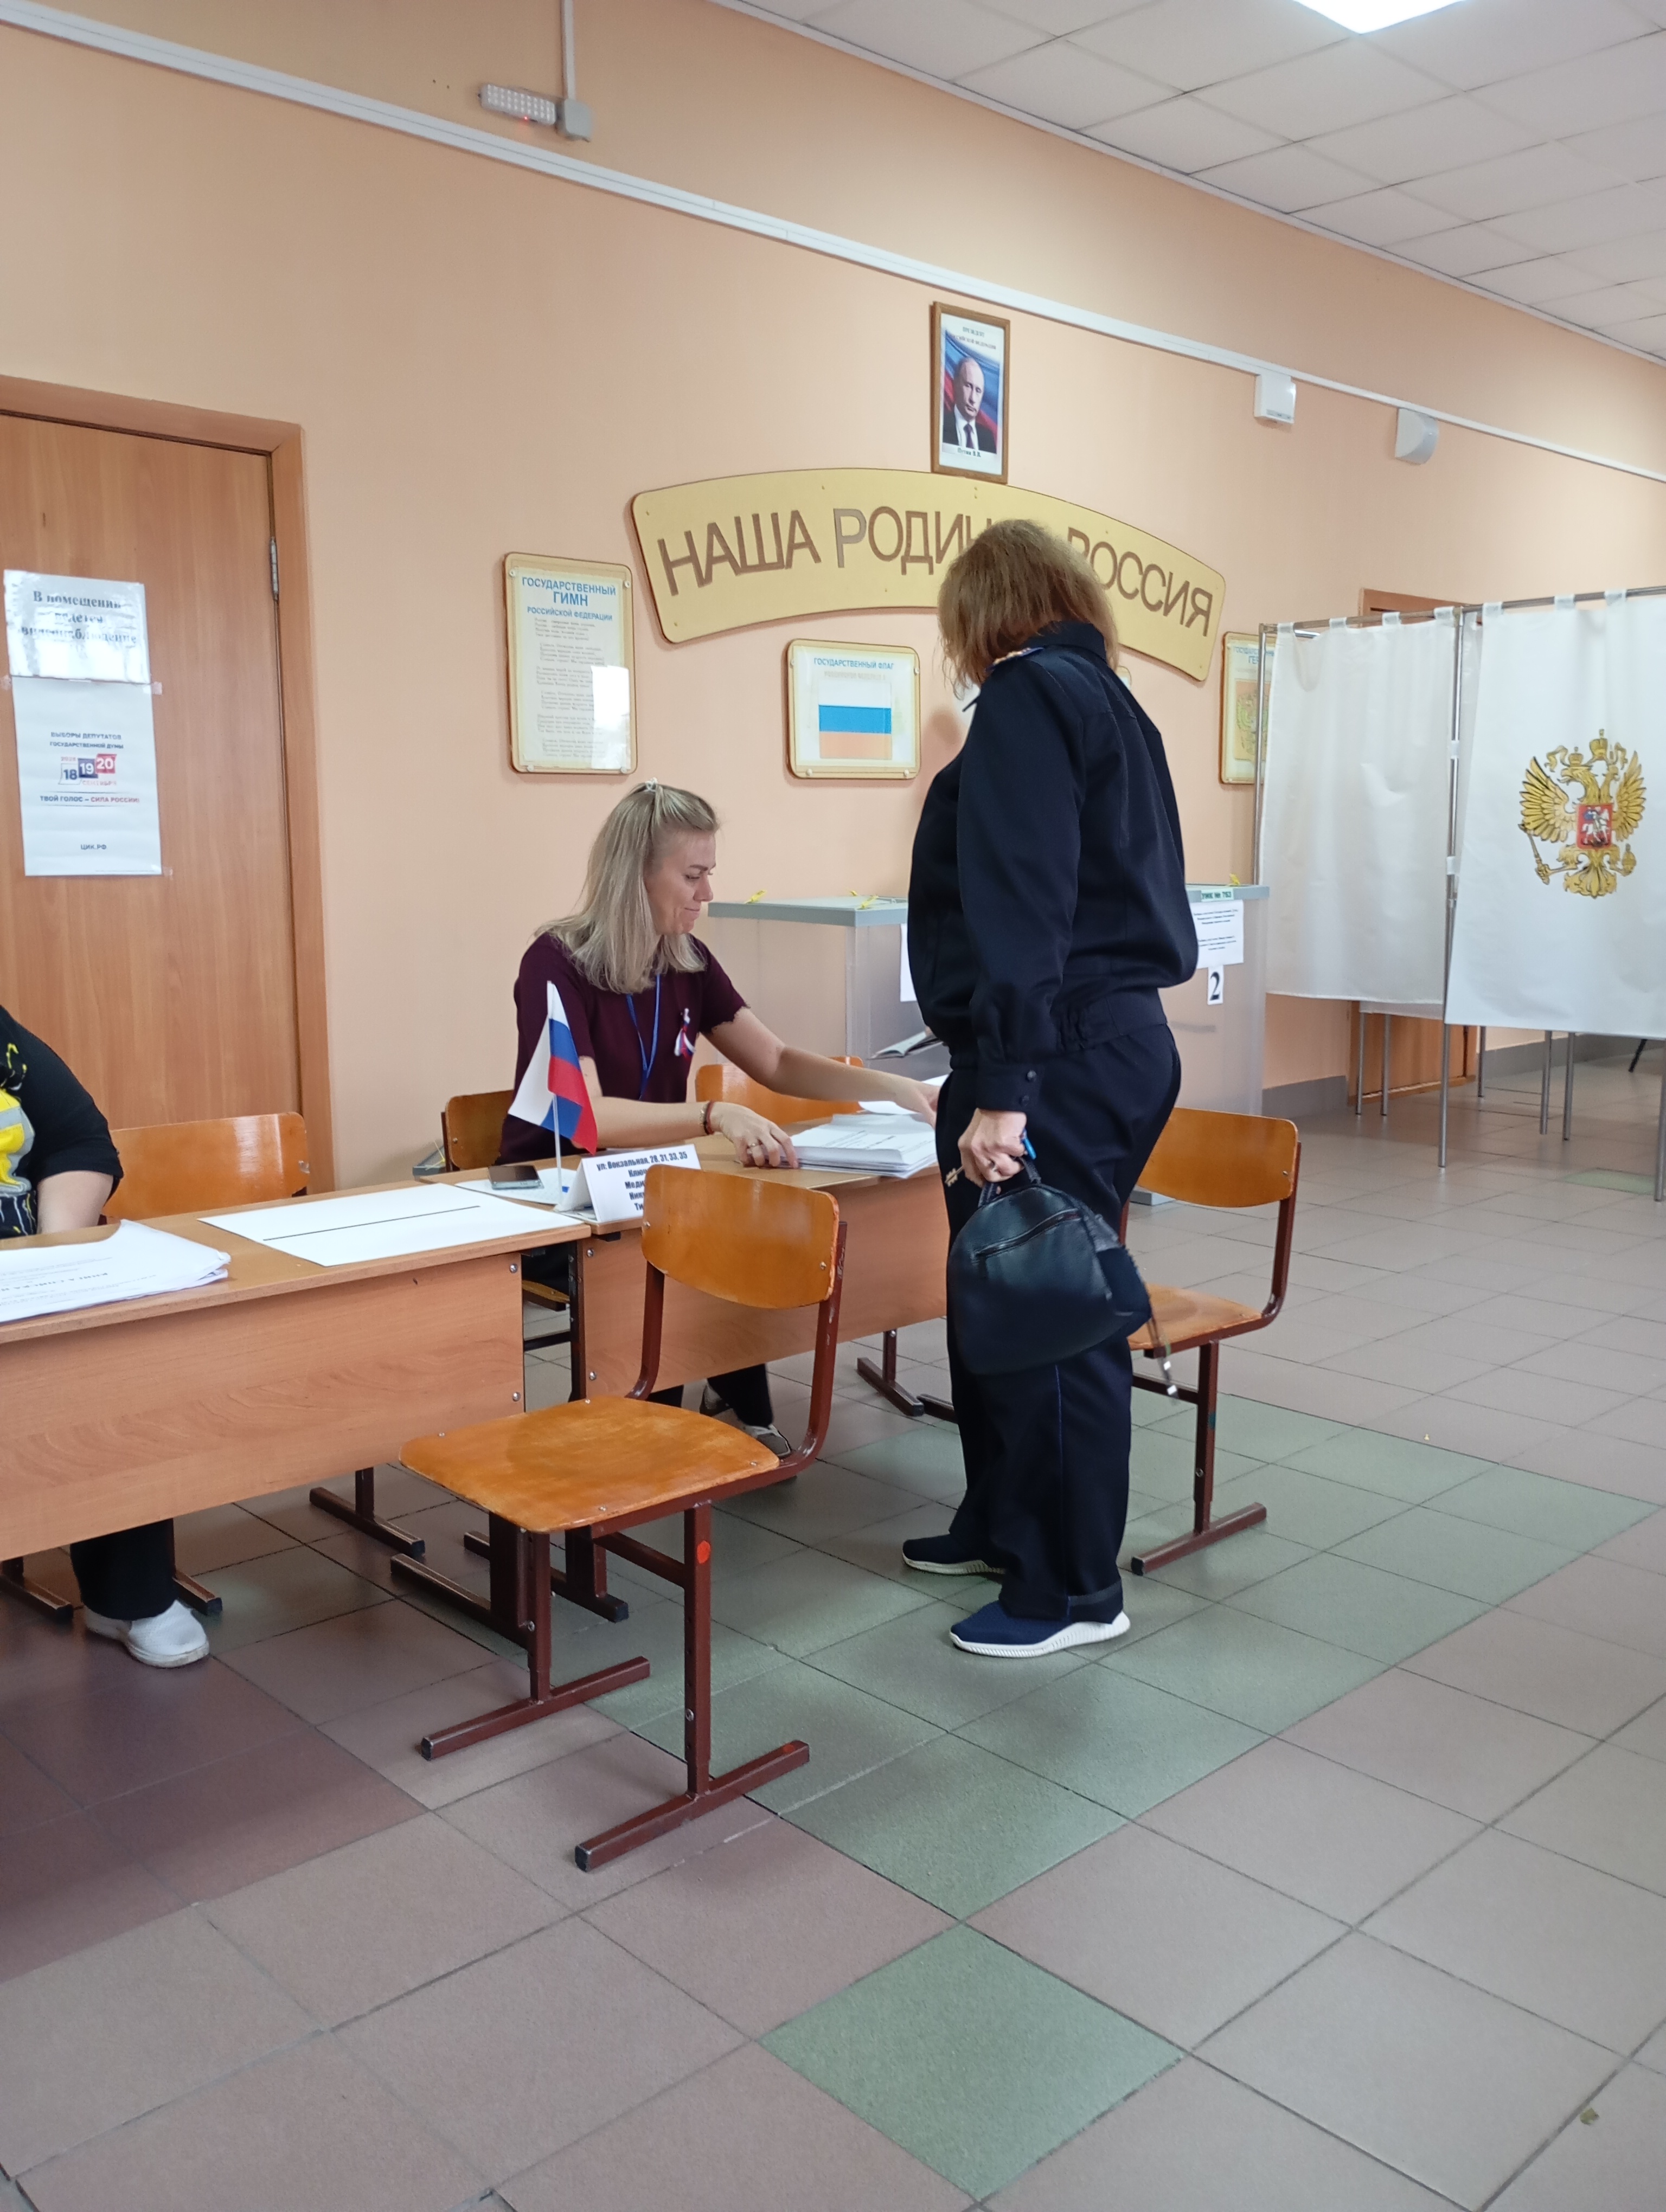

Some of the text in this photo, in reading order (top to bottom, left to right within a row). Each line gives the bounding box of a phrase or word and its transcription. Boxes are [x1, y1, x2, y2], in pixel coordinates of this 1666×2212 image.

[657, 510, 822, 596] НАША
[834, 506, 992, 575] РОДИ
[522, 577, 616, 595] ГОСУДАРСТВЕННЫЙ
[33, 590, 42, 602] В
[553, 591, 588, 606] ГИМН
[527, 606, 612, 621] РОССИЙСКОЙ ФЕДЕРАЦИИ
[814, 658, 876, 668] ГОСУДАРСТВЕННЫЙ
[63, 758, 113, 780] 18 19 20
[1209, 971, 1221, 1001] 2
[607, 1157, 650, 1169] Вокзальная,
[679, 1151, 688, 1160] 35
